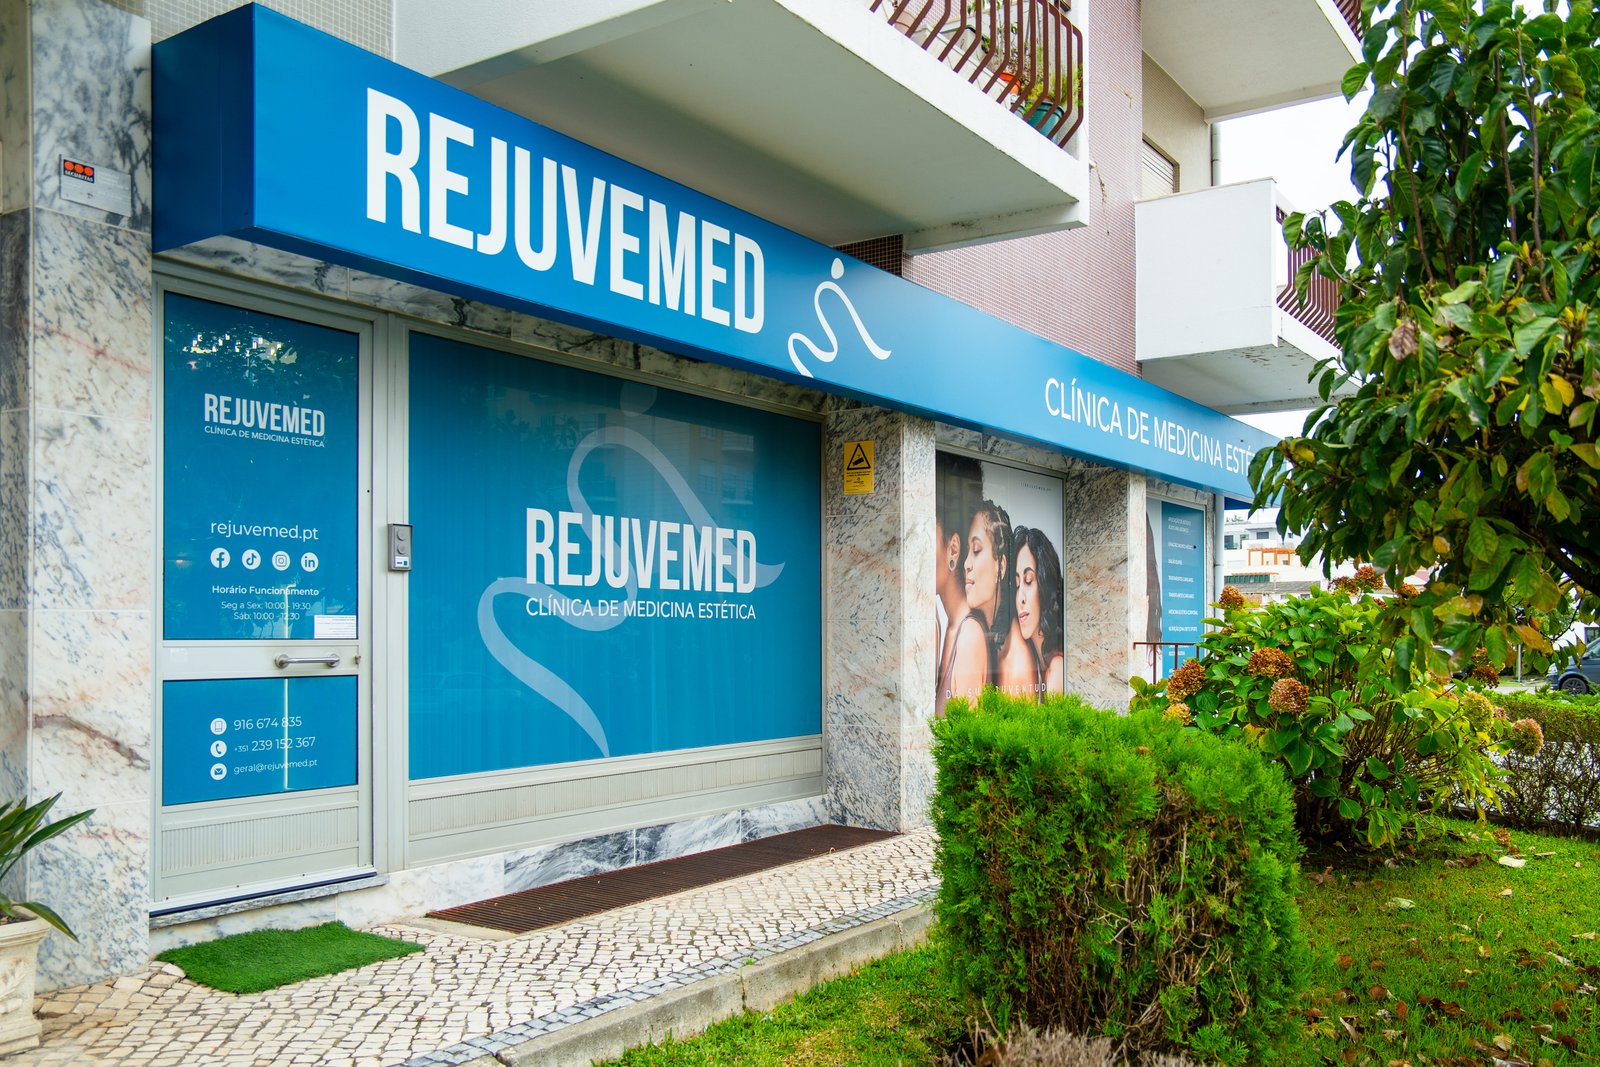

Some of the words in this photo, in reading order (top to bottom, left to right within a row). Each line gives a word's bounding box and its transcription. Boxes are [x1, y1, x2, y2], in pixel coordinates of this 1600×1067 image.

[367, 87, 765, 334] REJUVEMED
[204, 393, 325, 437] REJUVEMED
[204, 425, 237, 437] CLÍNICA
[239, 430, 250, 439] DE
[251, 432, 290, 443] MEDICINA
[291, 437, 325, 448] ESTÉTICA
[1045, 377, 1123, 437] CLÍNICA
[1127, 406, 1149, 445] DE
[1153, 416, 1223, 469] MEDICINA
[1226, 442, 1257, 477] ESTÉ
[210, 520, 319, 542] rejuvemed.pt
[526, 507, 757, 593] REJUVEMED
[212, 585, 247, 594] Horário
[249, 586, 319, 596] Funcionamento
[221, 601, 238, 610] Seg
[292, 602, 311, 610] 19:30
[525, 594, 594, 617] CLÍNICA
[598, 600, 619, 617] DE
[623, 600, 695, 618] MEDICINA
[698, 600, 757, 620] ESTÉTICA
[253, 612, 274, 620] 10:00
[281, 612, 300, 620] 1230
[995, 683, 1046, 697] JUVENTUD
[234, 719, 253, 730] 916
[256, 718, 279, 729] 674
[281, 716, 302, 728] 835
[234, 745, 249, 753] +351
[251, 740, 272, 751] 239
[275, 738, 293, 749] 152
[295, 737, 316, 748] 367
[233, 759, 318, 775] geral@rejuvmed.pt
